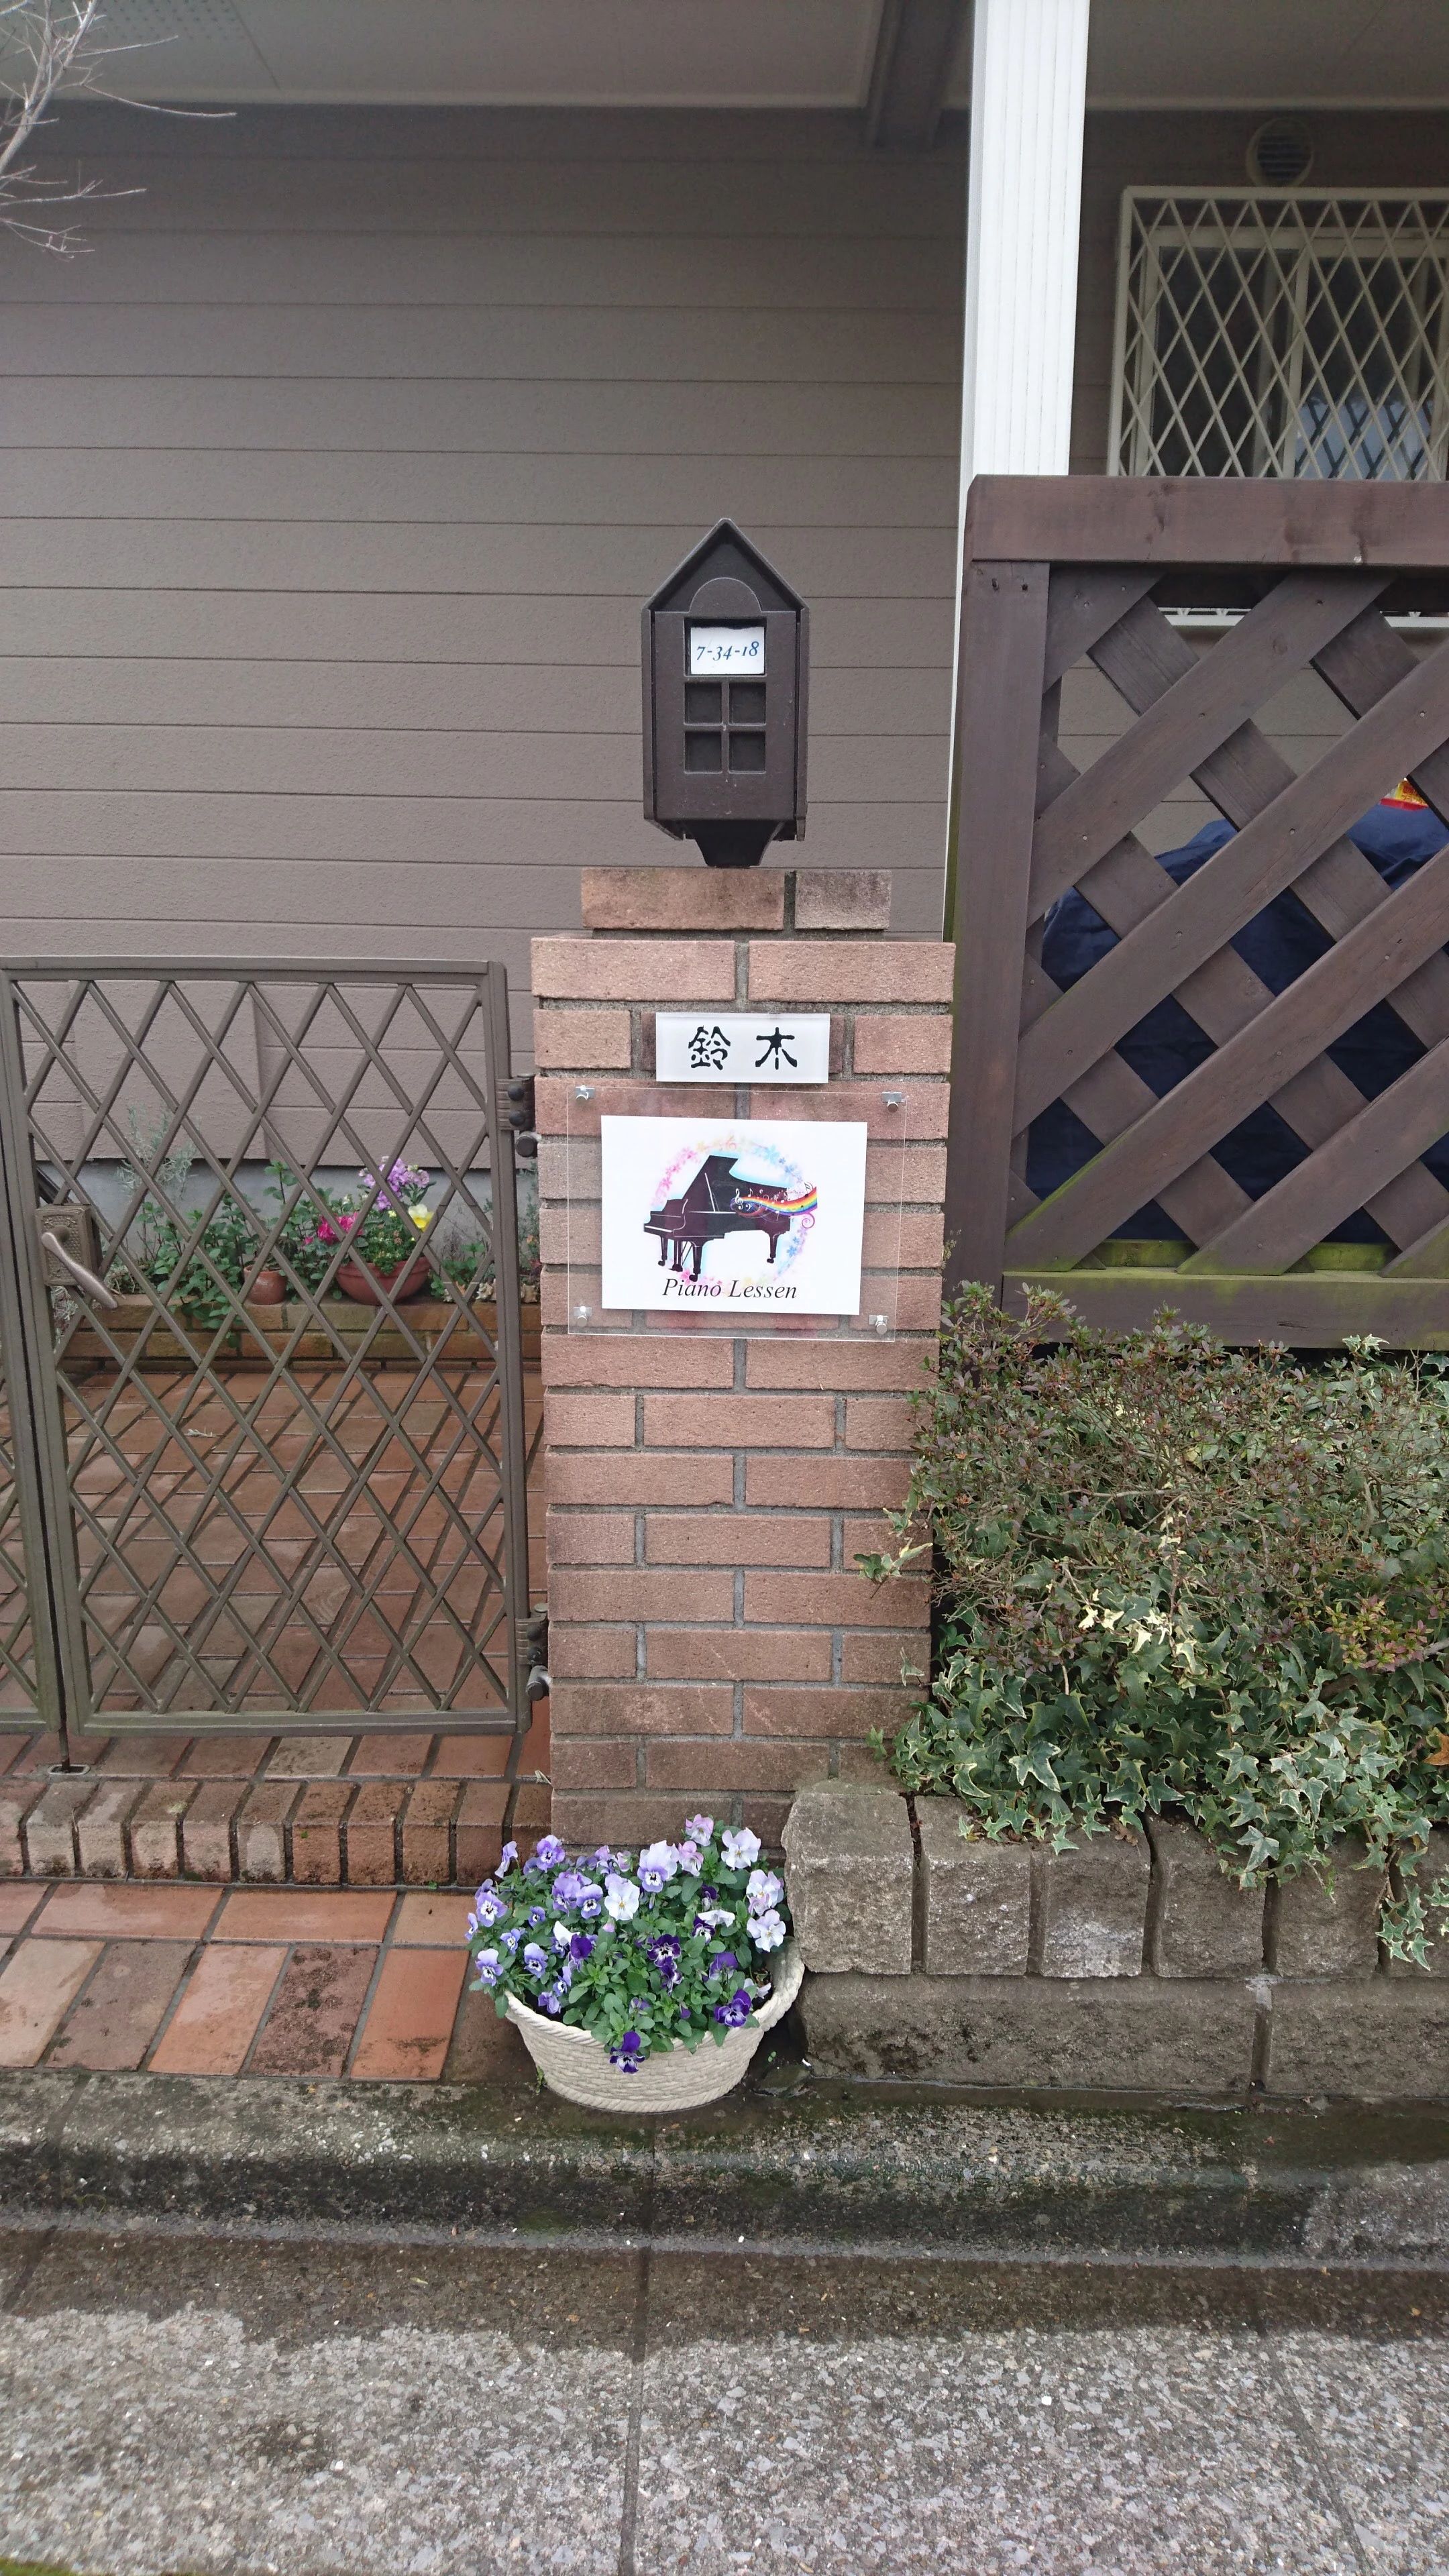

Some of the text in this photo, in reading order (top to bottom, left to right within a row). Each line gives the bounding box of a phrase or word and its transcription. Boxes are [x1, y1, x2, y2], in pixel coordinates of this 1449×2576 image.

[696, 641, 760, 661] 7-34-18
[688, 1026, 798, 1071] 鈴木
[661, 1278, 797, 1299] Piano Lessen
